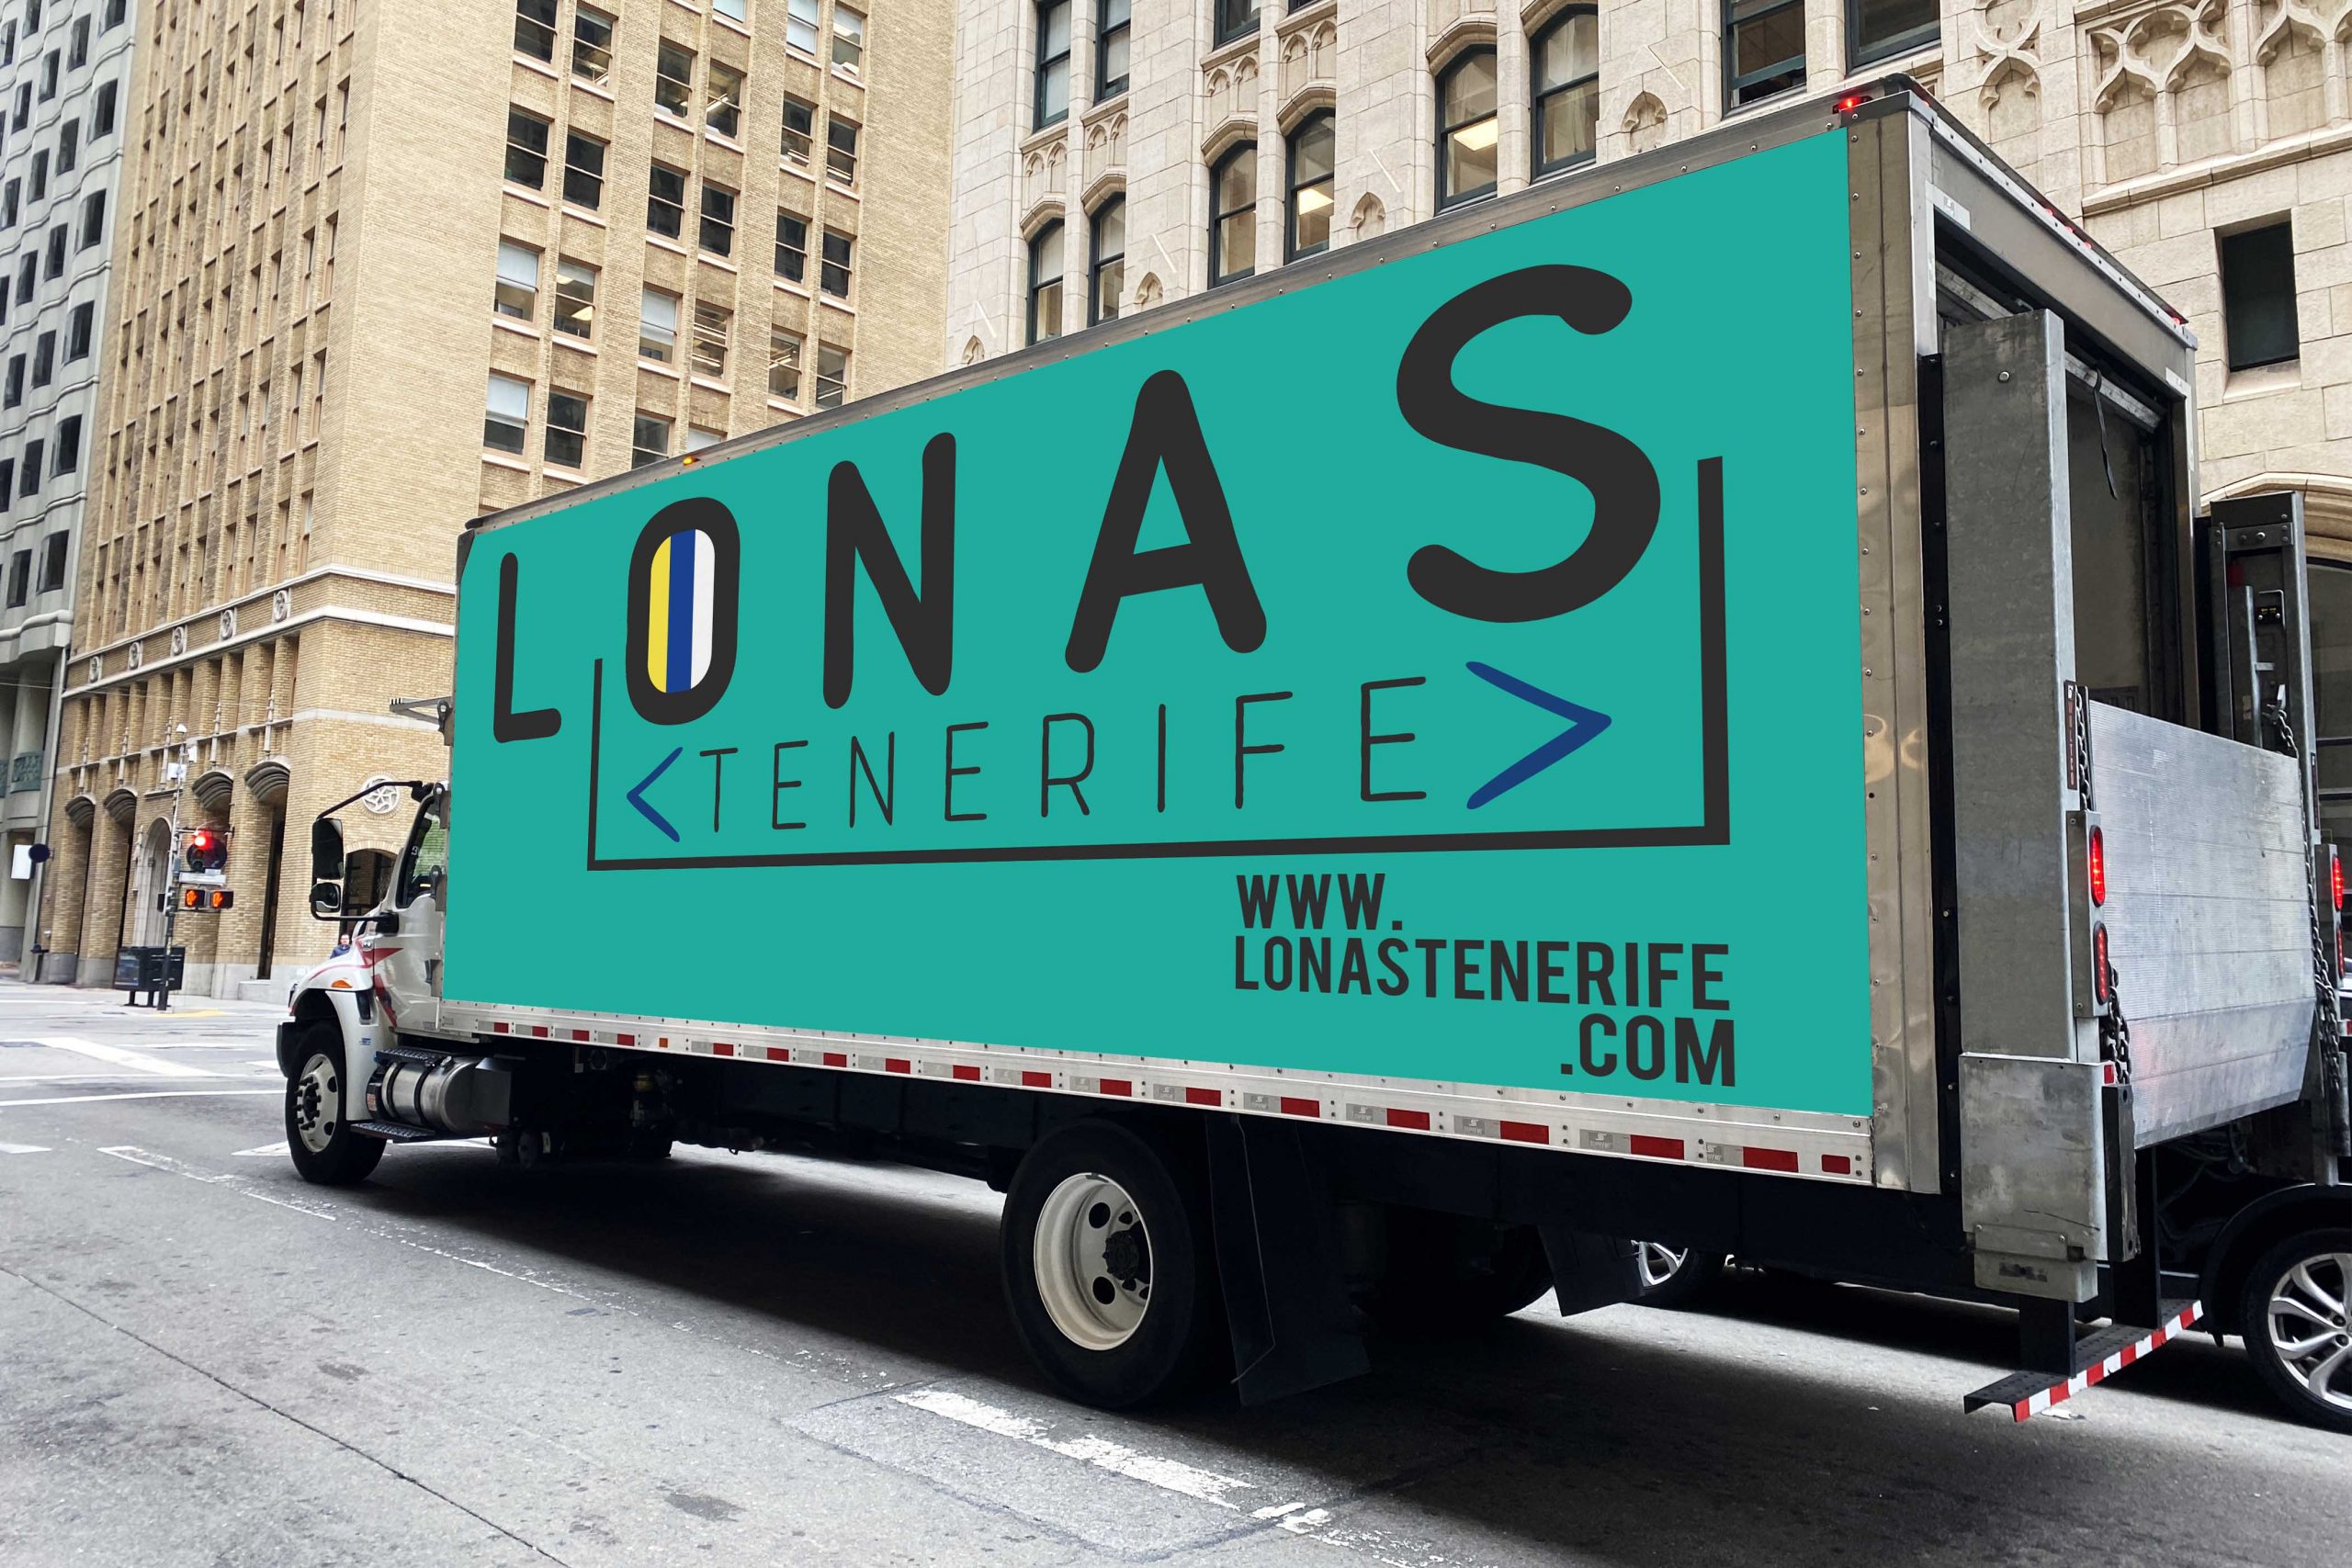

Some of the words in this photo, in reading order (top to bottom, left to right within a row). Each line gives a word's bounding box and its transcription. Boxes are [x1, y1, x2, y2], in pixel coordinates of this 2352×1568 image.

[493, 265, 1660, 743] LONAS
[1237, 874, 1403, 931] WWW.
[1236, 936, 1729, 1010] LONASTENERIFE
[1561, 1013, 1735, 1087] .COM
